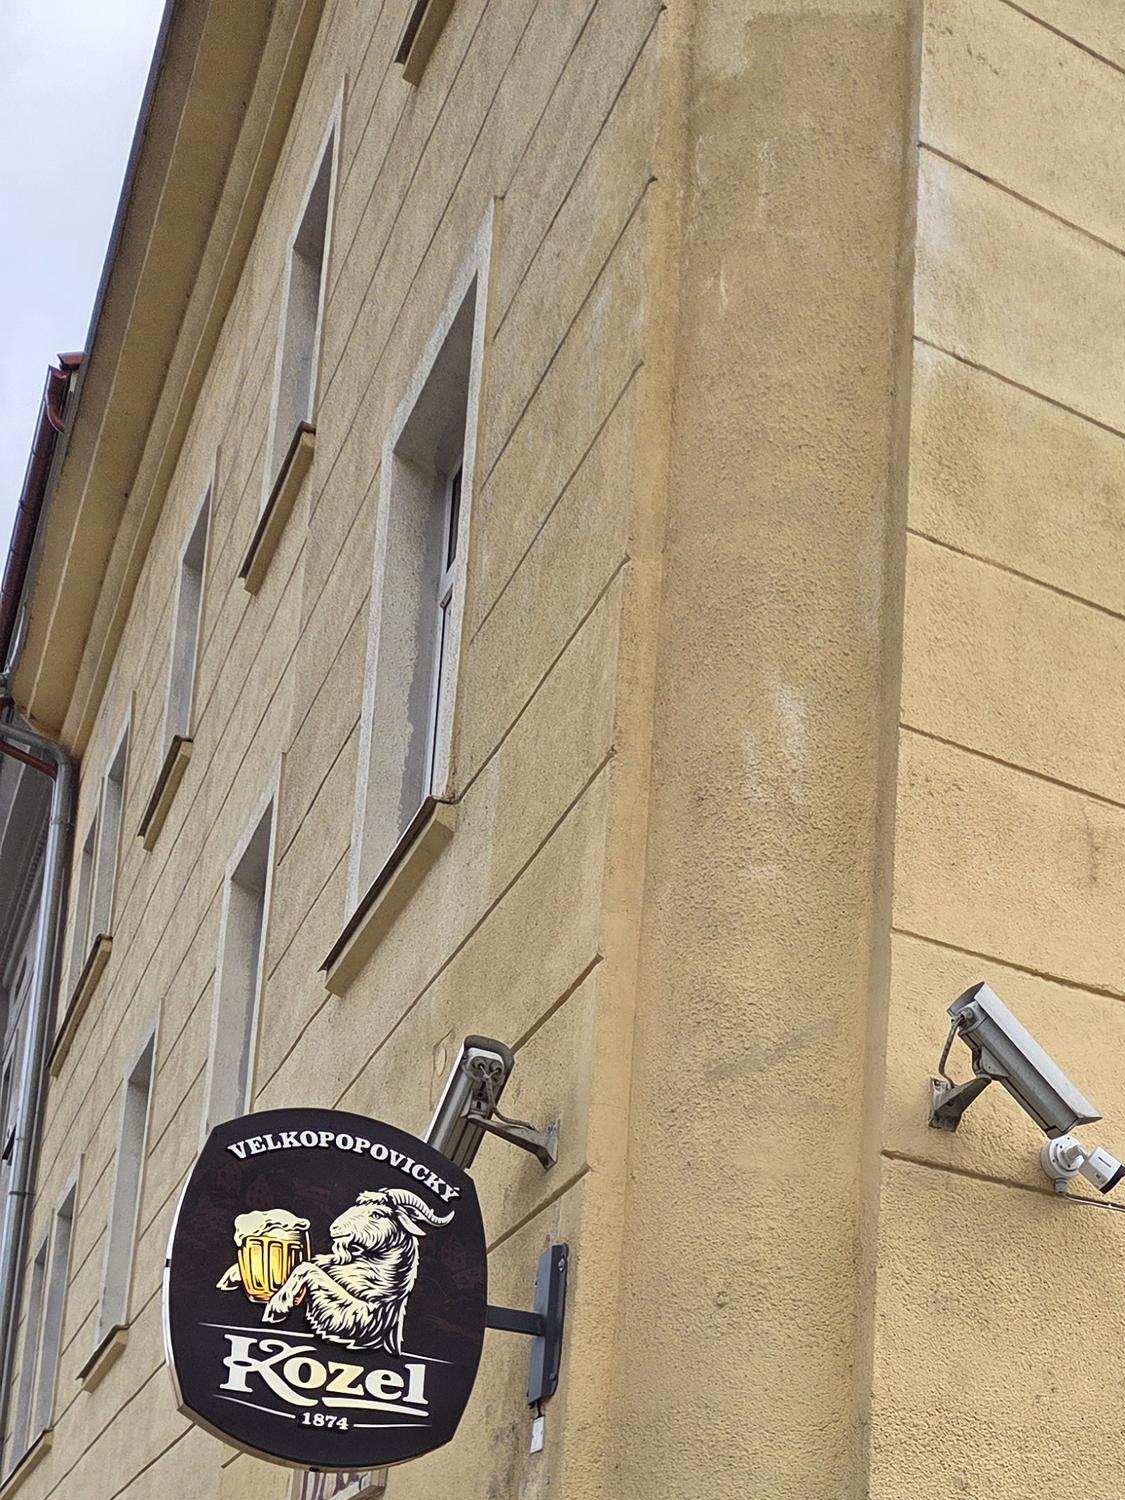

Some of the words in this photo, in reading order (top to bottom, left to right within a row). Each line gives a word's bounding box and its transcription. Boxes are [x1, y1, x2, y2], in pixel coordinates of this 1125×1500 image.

[228, 1130, 461, 1202] VELKOPOPOVICKÝ
[219, 1334, 430, 1407] Kozel
[301, 1412, 350, 1431] 1874
